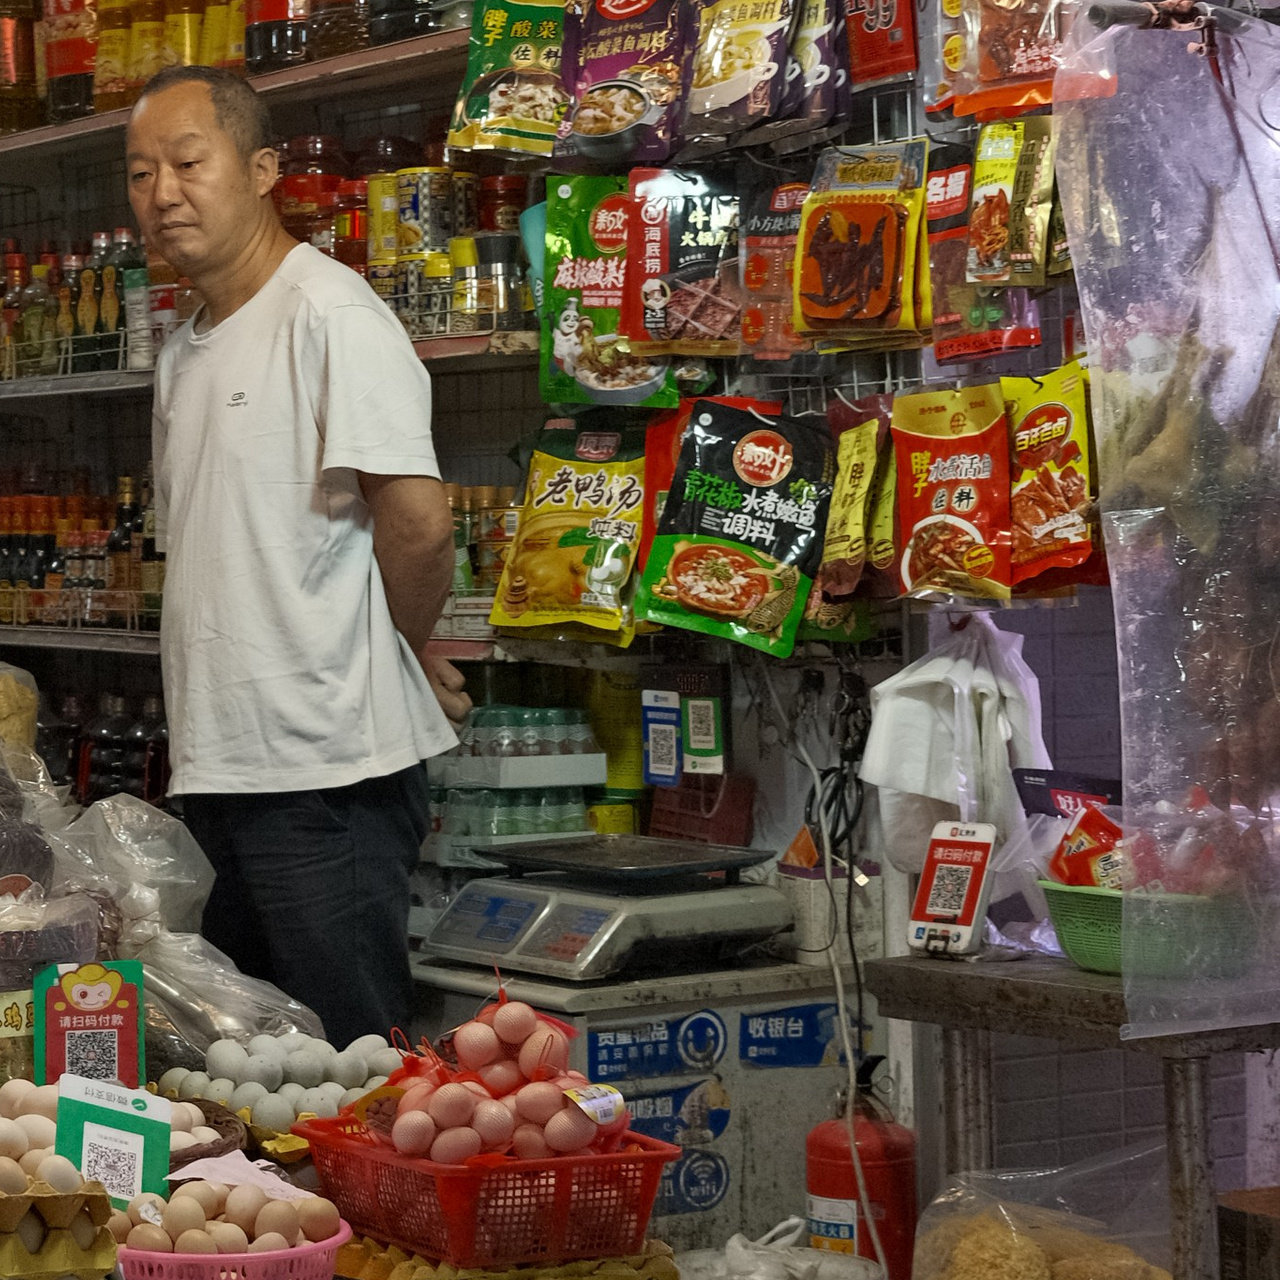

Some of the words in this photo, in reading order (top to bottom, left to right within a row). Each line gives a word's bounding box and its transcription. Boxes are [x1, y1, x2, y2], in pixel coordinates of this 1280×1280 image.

[510, 19, 559, 39] 酸菜
[644, 226, 662, 274] 海底捞
[536, 467, 643, 517] 老鸭汤
[683, 469, 743, 509] 青花椒
[721, 512, 776, 546] 调料
[933, 846, 984, 864] 请扫码付款
[59, 1014, 125, 1028] 请扫码付款
[748, 1016, 804, 1039] 收银台
